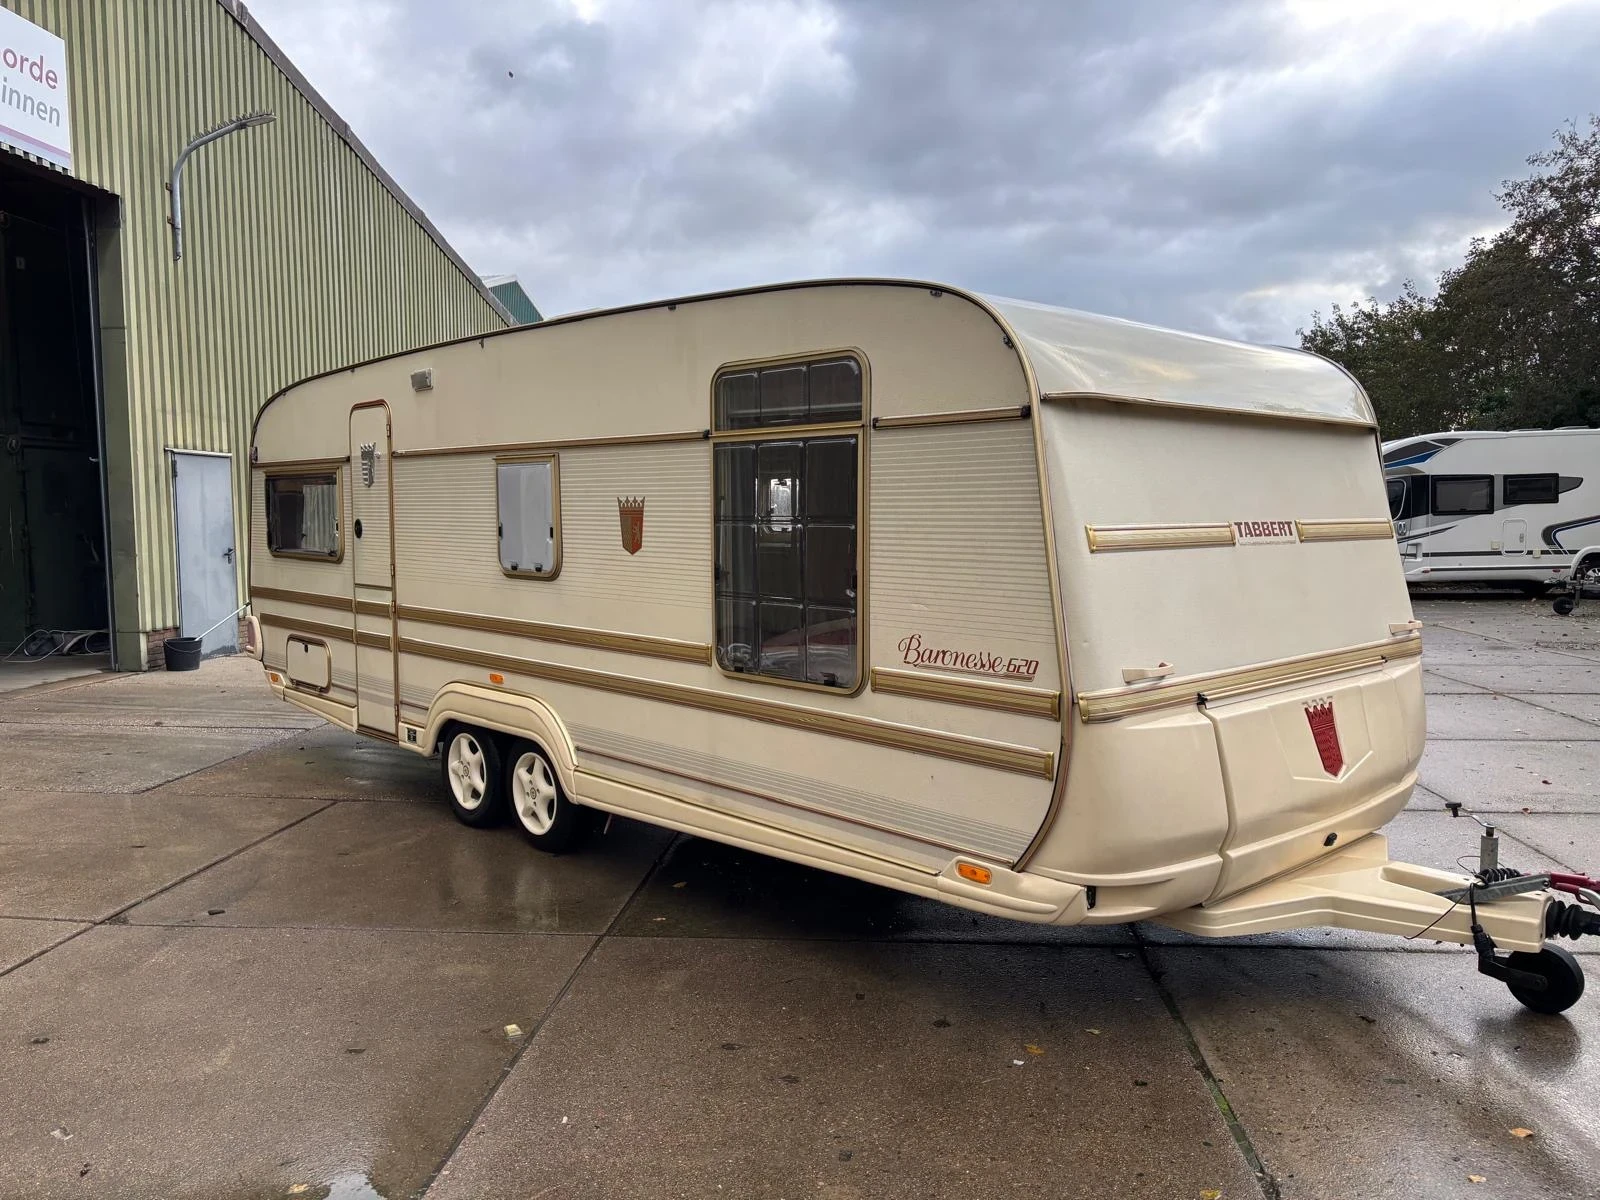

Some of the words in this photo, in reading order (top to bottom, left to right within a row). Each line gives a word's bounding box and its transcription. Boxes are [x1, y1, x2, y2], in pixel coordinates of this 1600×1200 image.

[0, 48, 58, 90] orde
[1, 76, 60, 127] innen
[1233, 521, 1293, 538] TABBERT
[898, 633, 1005, 673] Baronesse
[1006, 657, 1039, 675] 620
